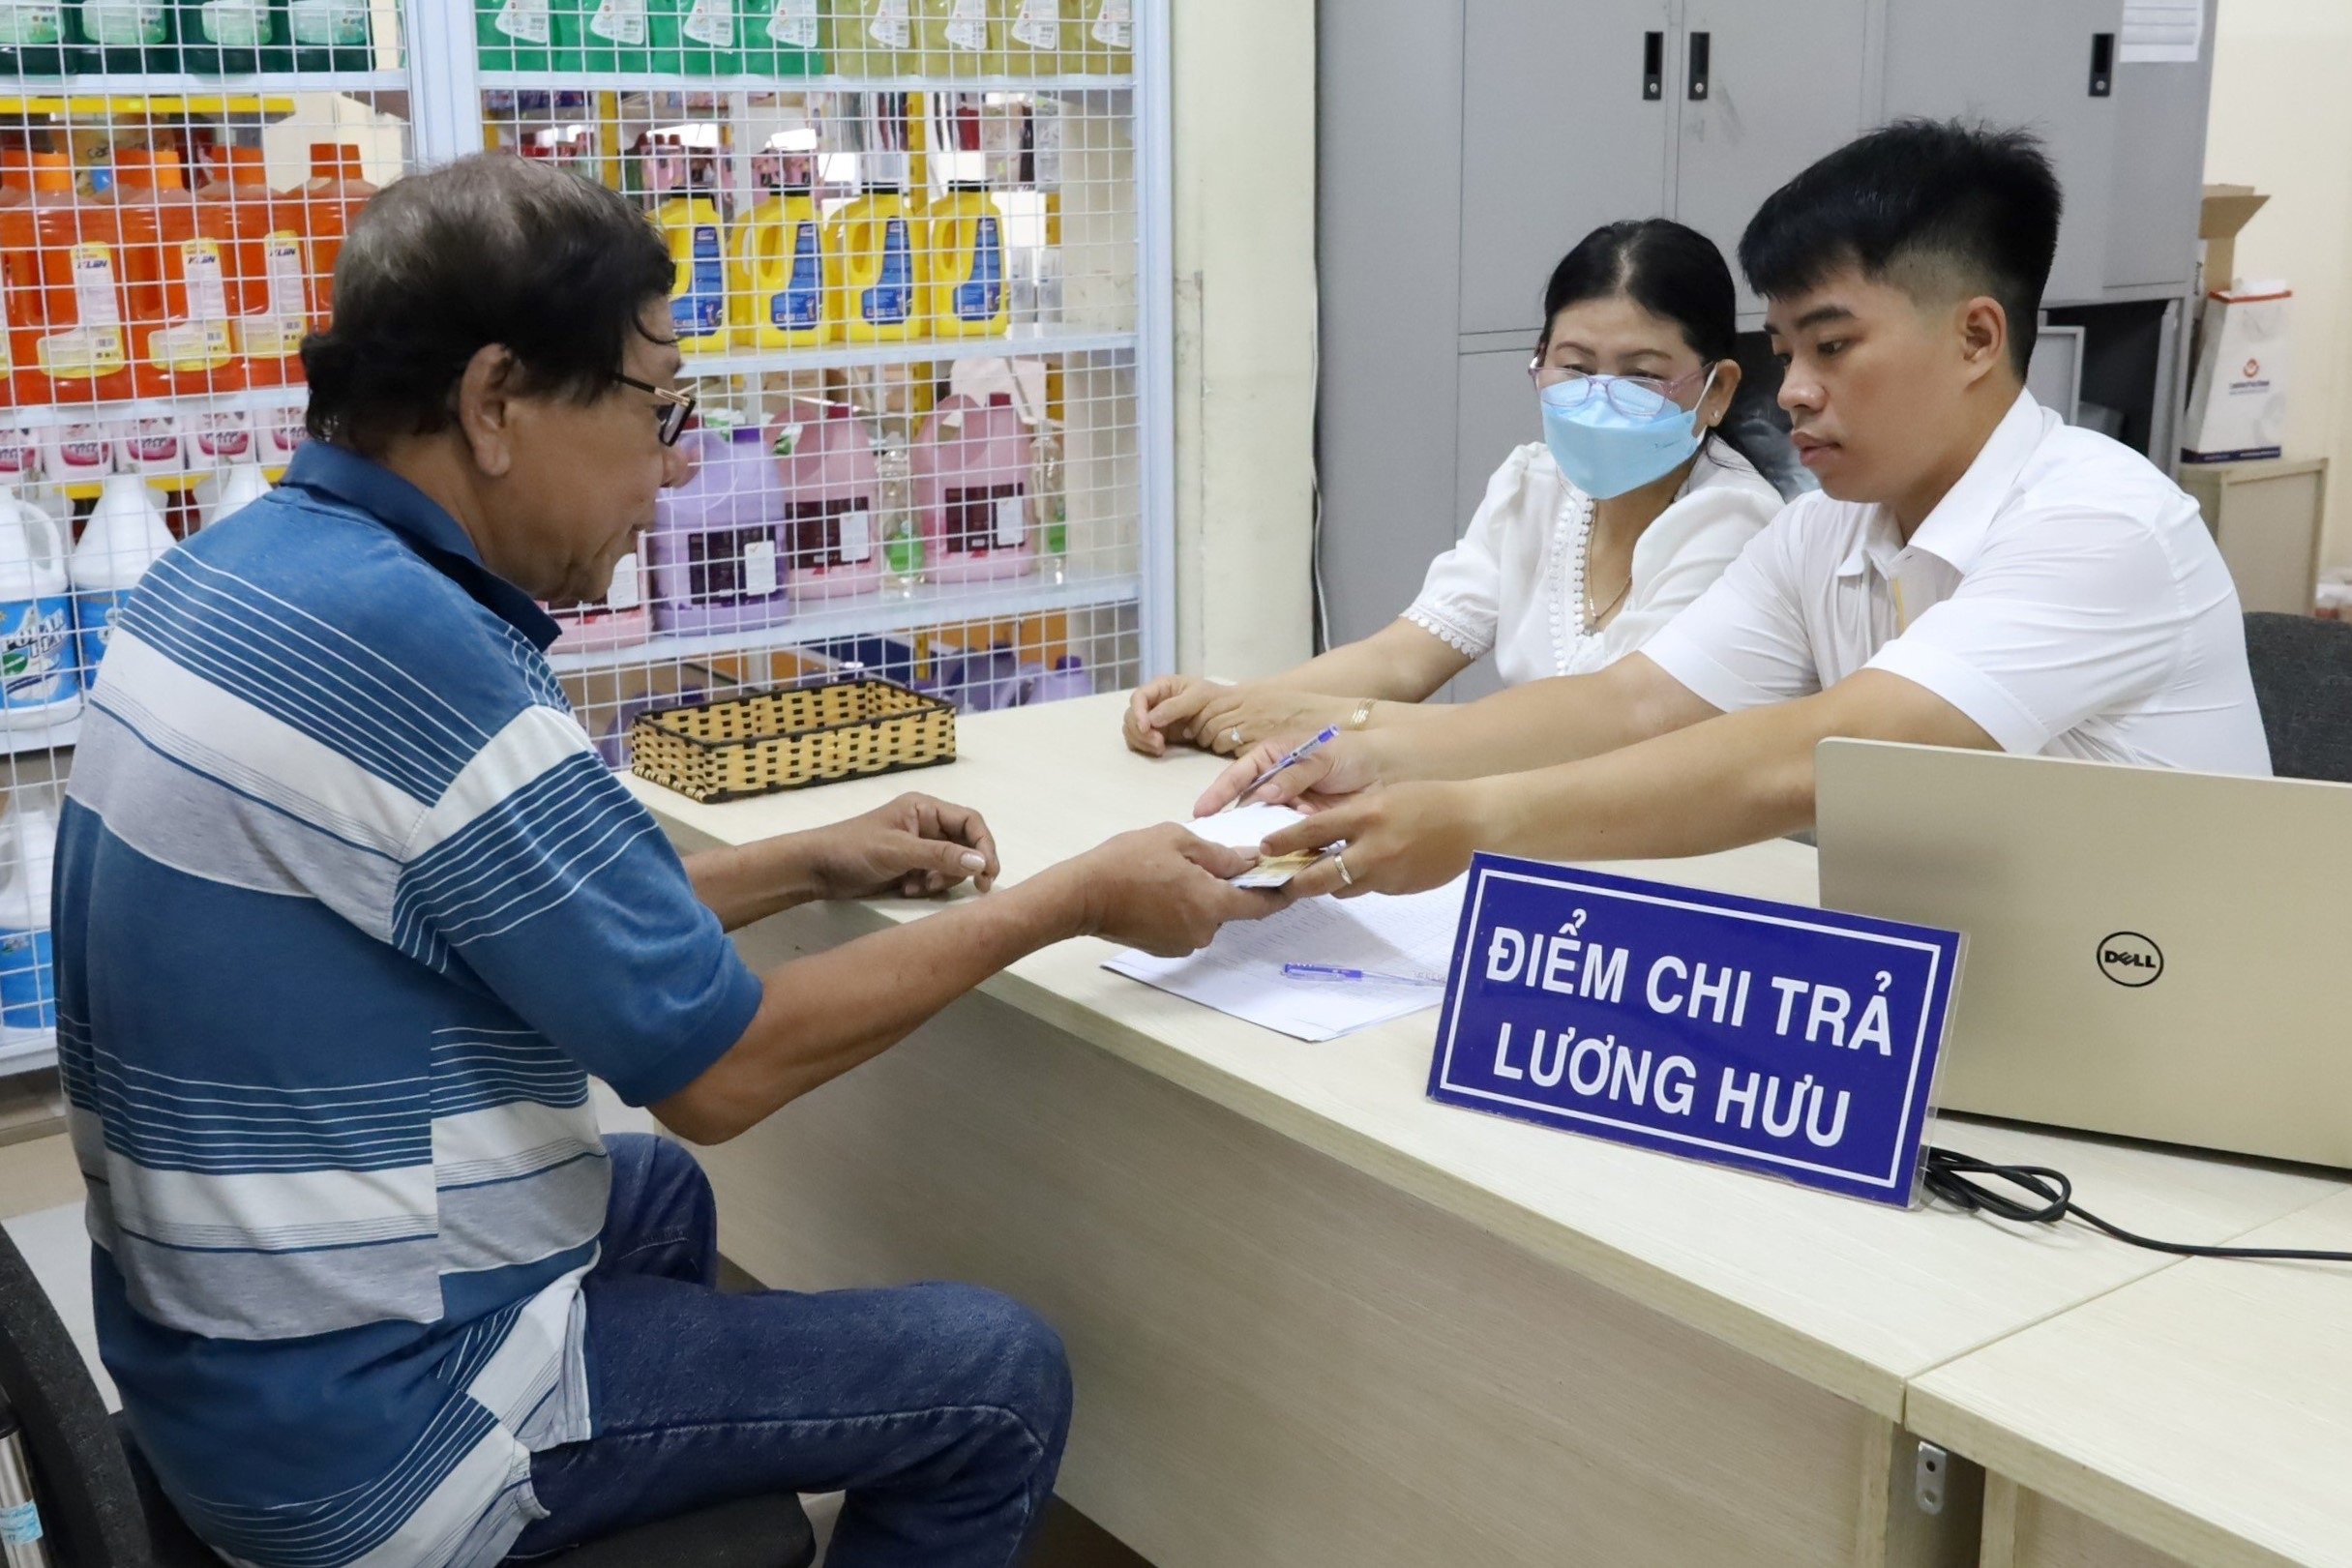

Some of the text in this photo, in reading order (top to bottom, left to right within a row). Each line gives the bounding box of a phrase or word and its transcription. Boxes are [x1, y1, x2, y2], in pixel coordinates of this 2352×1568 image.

[1486, 908, 1892, 1056] ĐIỂM CHI TRẢ
[2104, 950, 2157, 968] DELL
[1494, 1022, 1851, 1147] LƯƠNG HƯU
